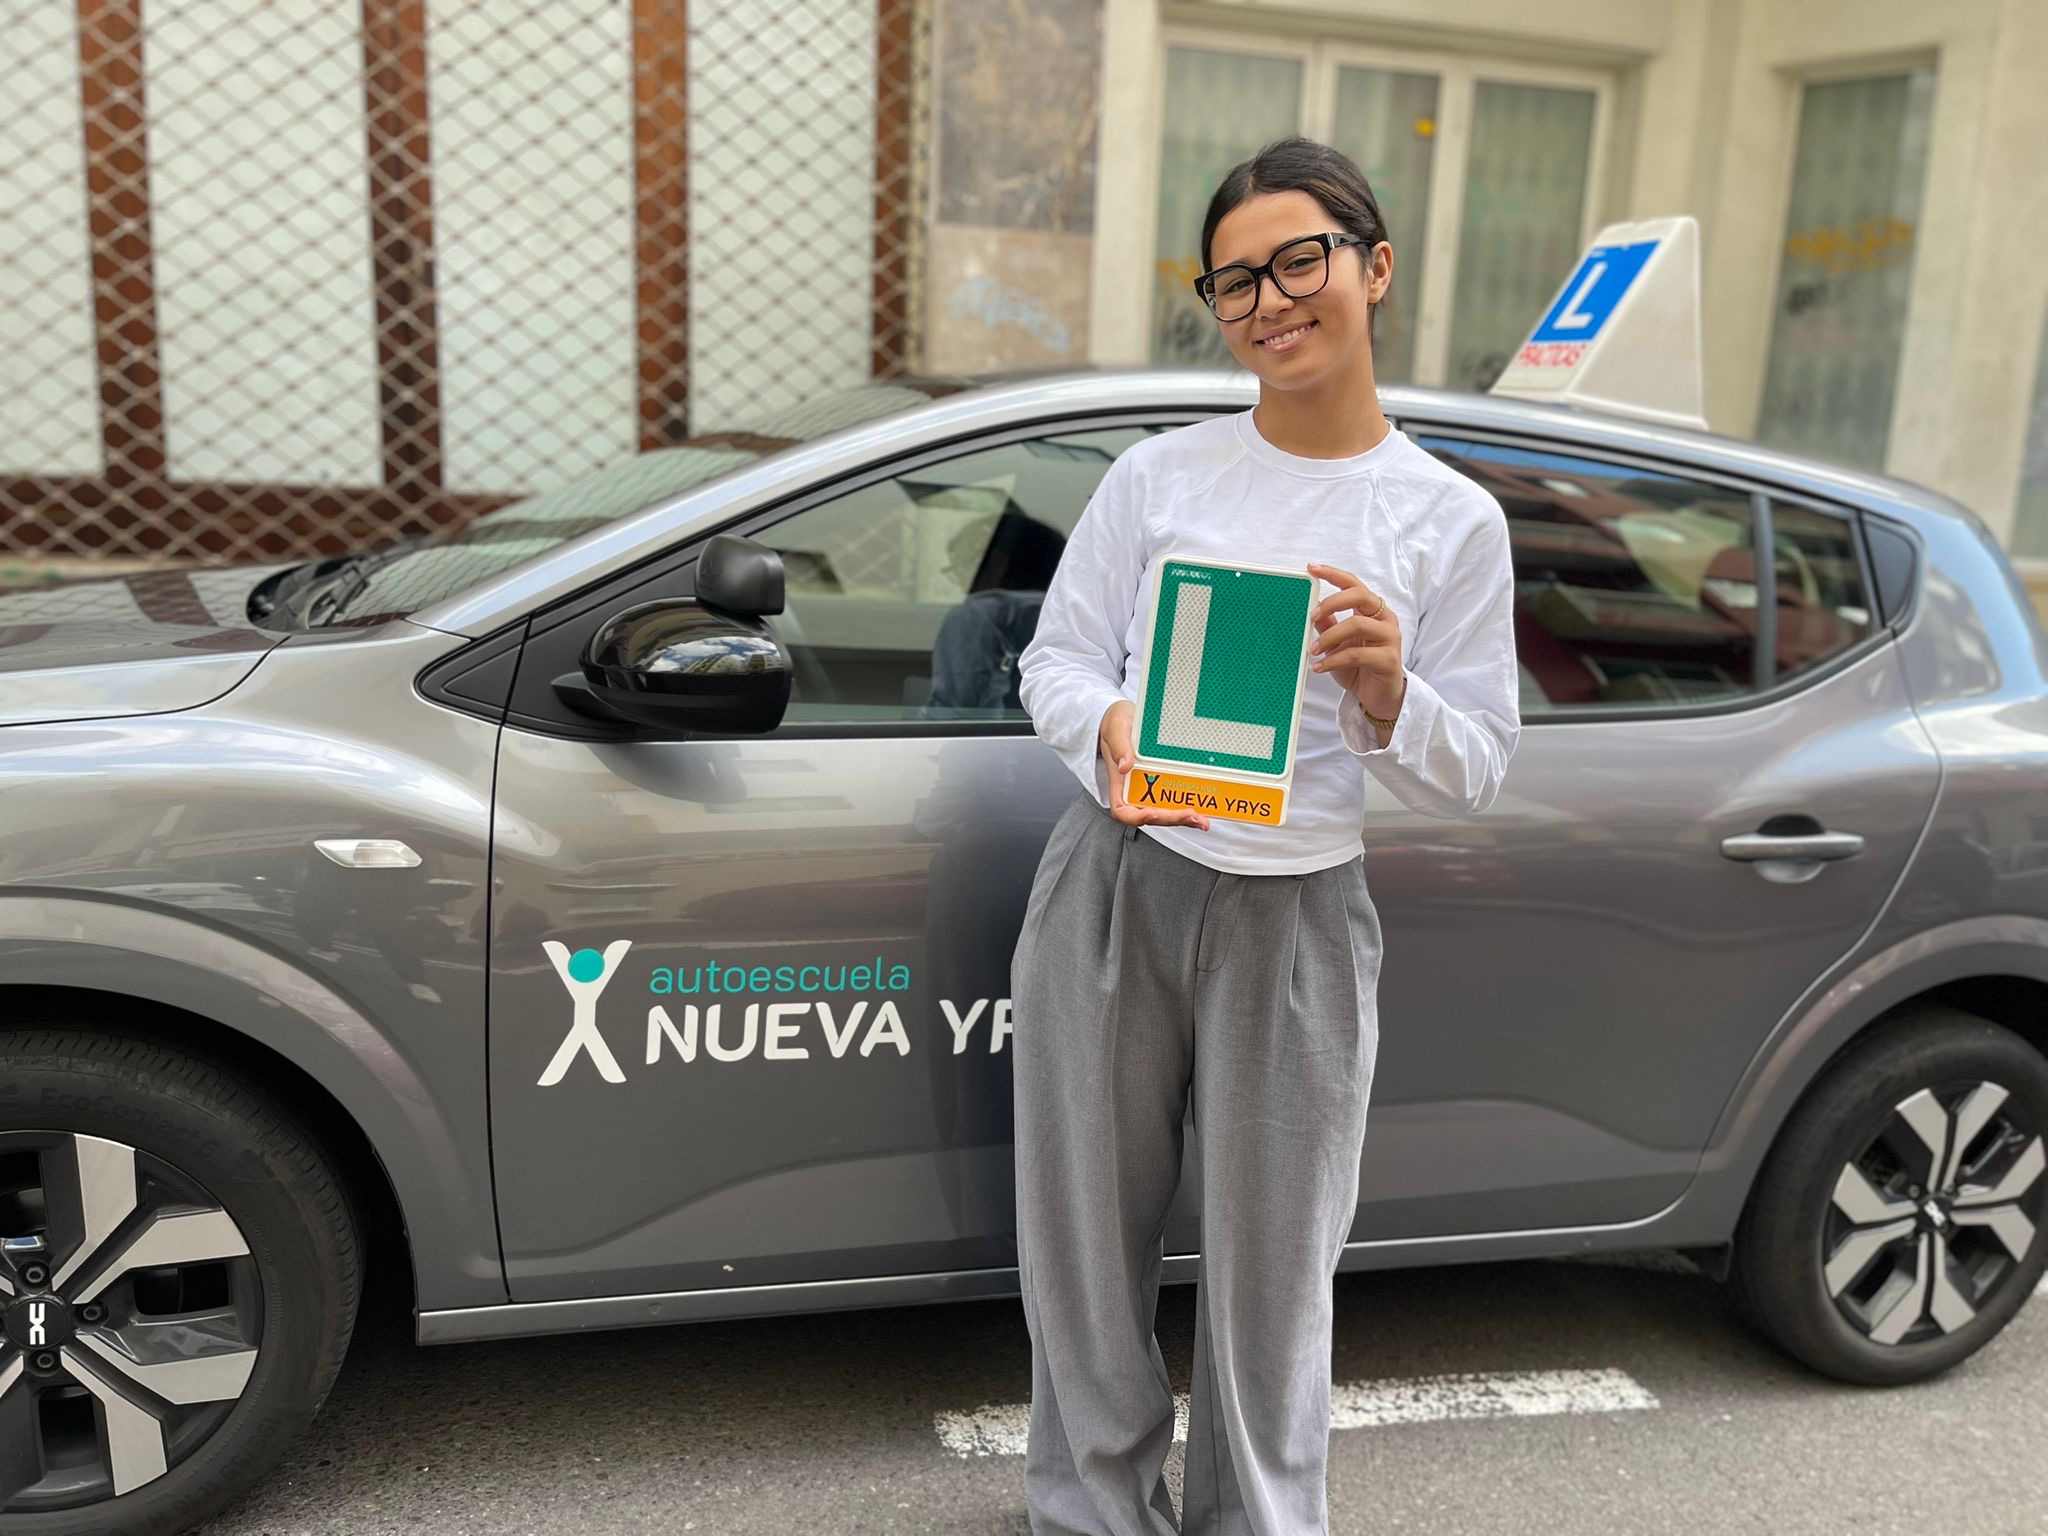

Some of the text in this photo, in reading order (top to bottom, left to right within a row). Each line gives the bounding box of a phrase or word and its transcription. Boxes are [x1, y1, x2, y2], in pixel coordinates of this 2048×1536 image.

[1552, 262, 1608, 329] L
[1157, 582, 1276, 760] L
[1160, 788, 1271, 817] NUEVA YRYS
[649, 956, 911, 994] autoescuela
[646, 1000, 911, 1065] NUEVA
[40, 1087, 200, 1144] EcoContact
